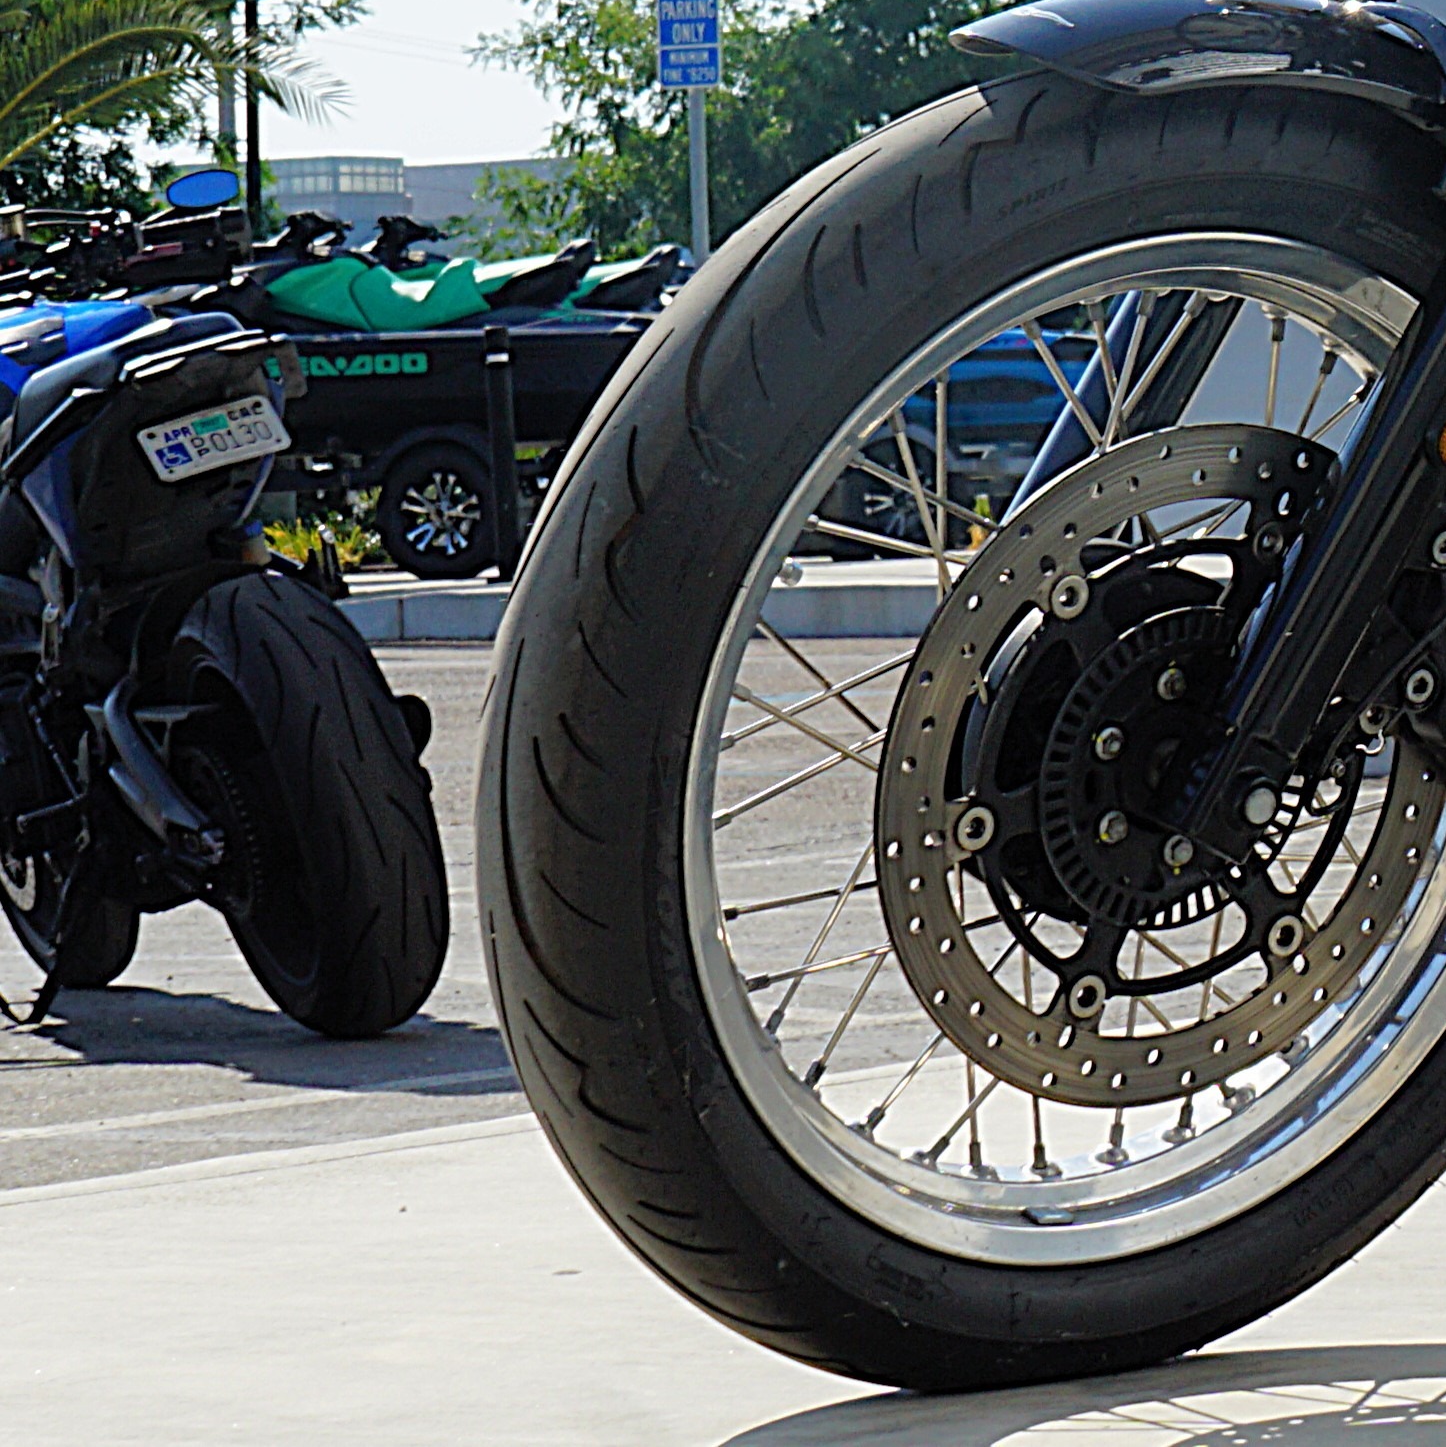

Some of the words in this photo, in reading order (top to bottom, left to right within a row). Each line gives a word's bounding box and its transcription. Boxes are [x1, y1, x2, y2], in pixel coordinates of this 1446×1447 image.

[661, 0, 715, 20] PARKING
[672, 22, 706, 43] ONLY
[163, 426, 192, 443] APR
